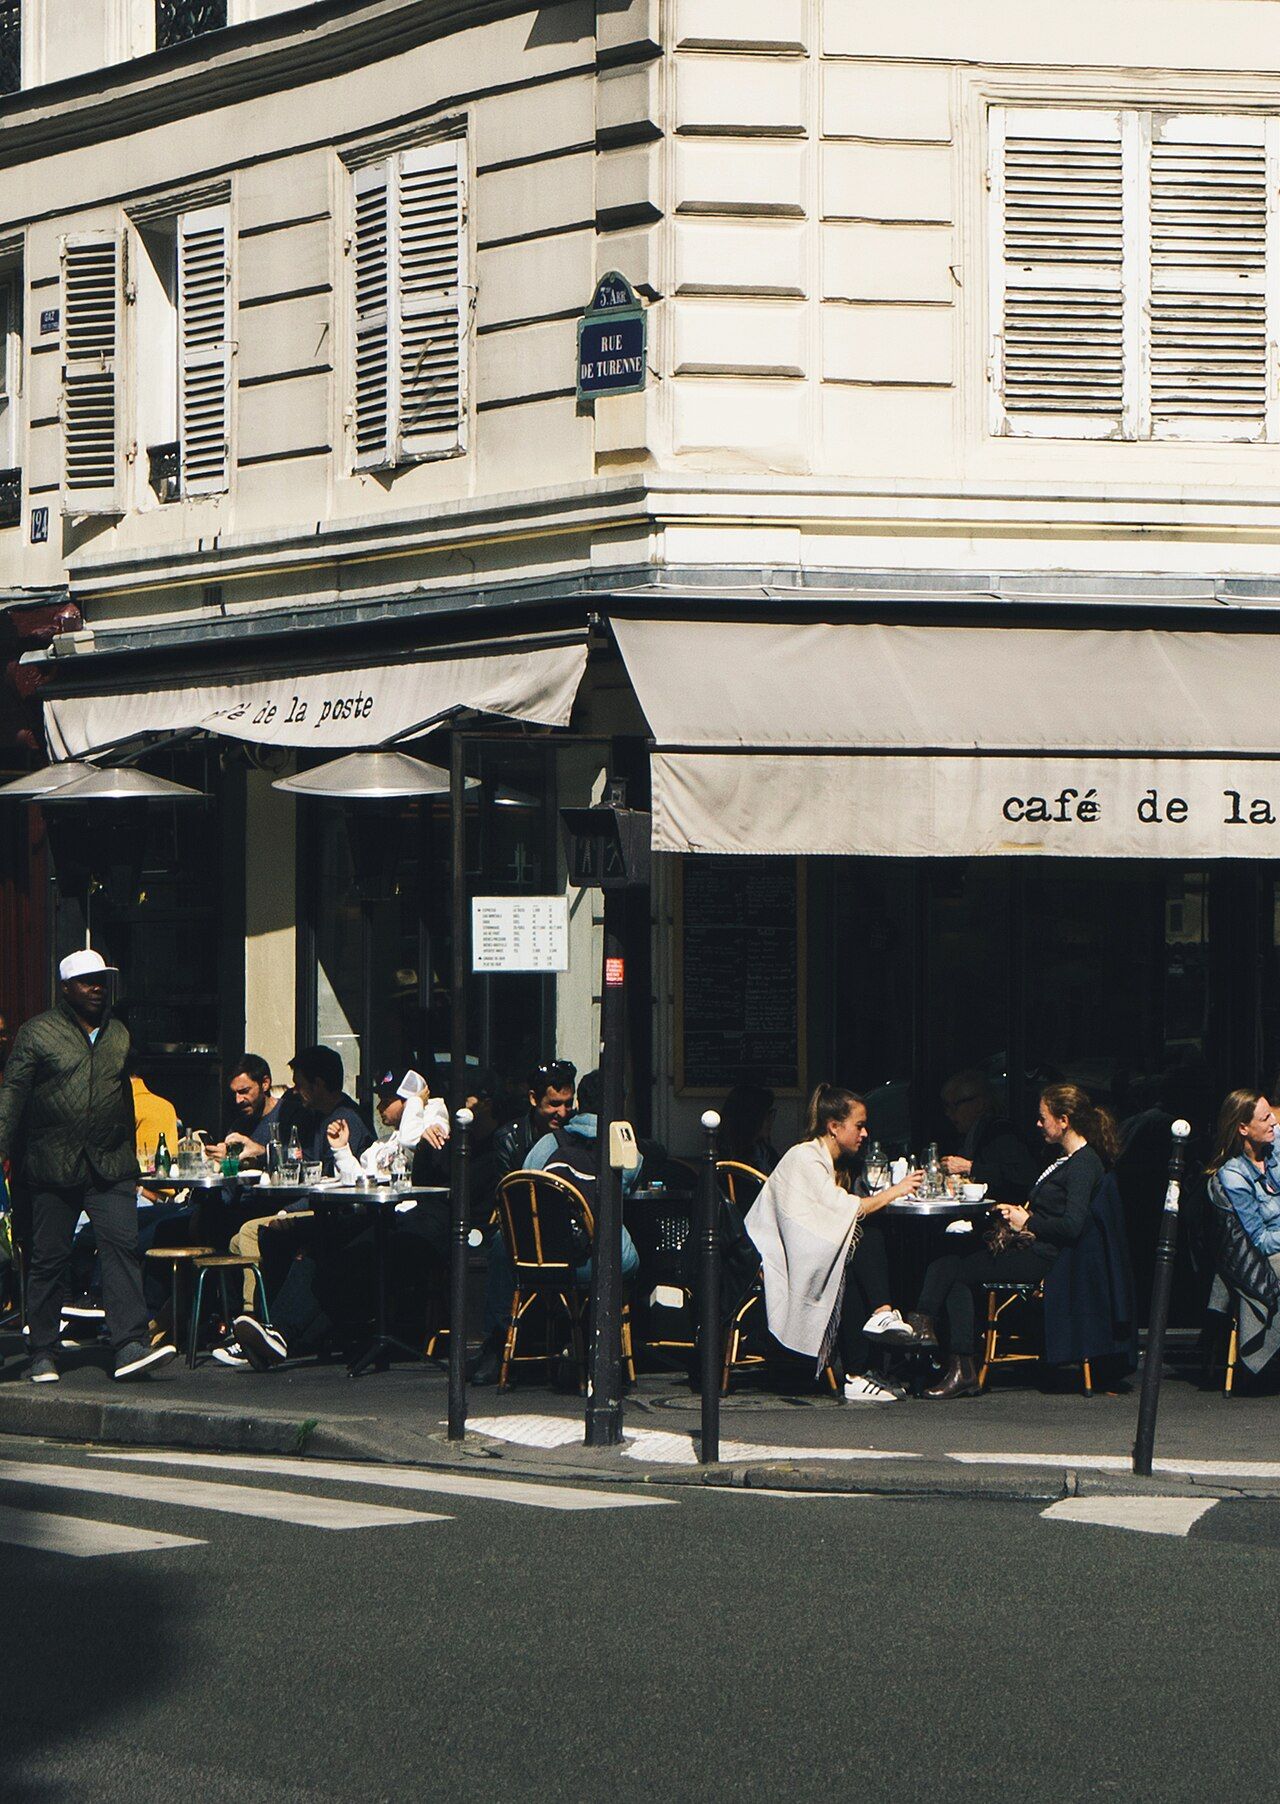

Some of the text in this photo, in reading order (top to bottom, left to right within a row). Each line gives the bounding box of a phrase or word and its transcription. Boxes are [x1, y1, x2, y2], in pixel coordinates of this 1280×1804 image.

[601, 335, 622, 352] RUE
[581, 357, 642, 379] DE TURENNE
[32, 510, 48, 540] 124
[252, 701, 277, 724] de
[284, 697, 307, 723] la
[314, 691, 373, 728] poste
[1002, 788, 1101, 822] café
[1136, 789, 1189, 824] de
[1223, 790, 1276, 824] la
